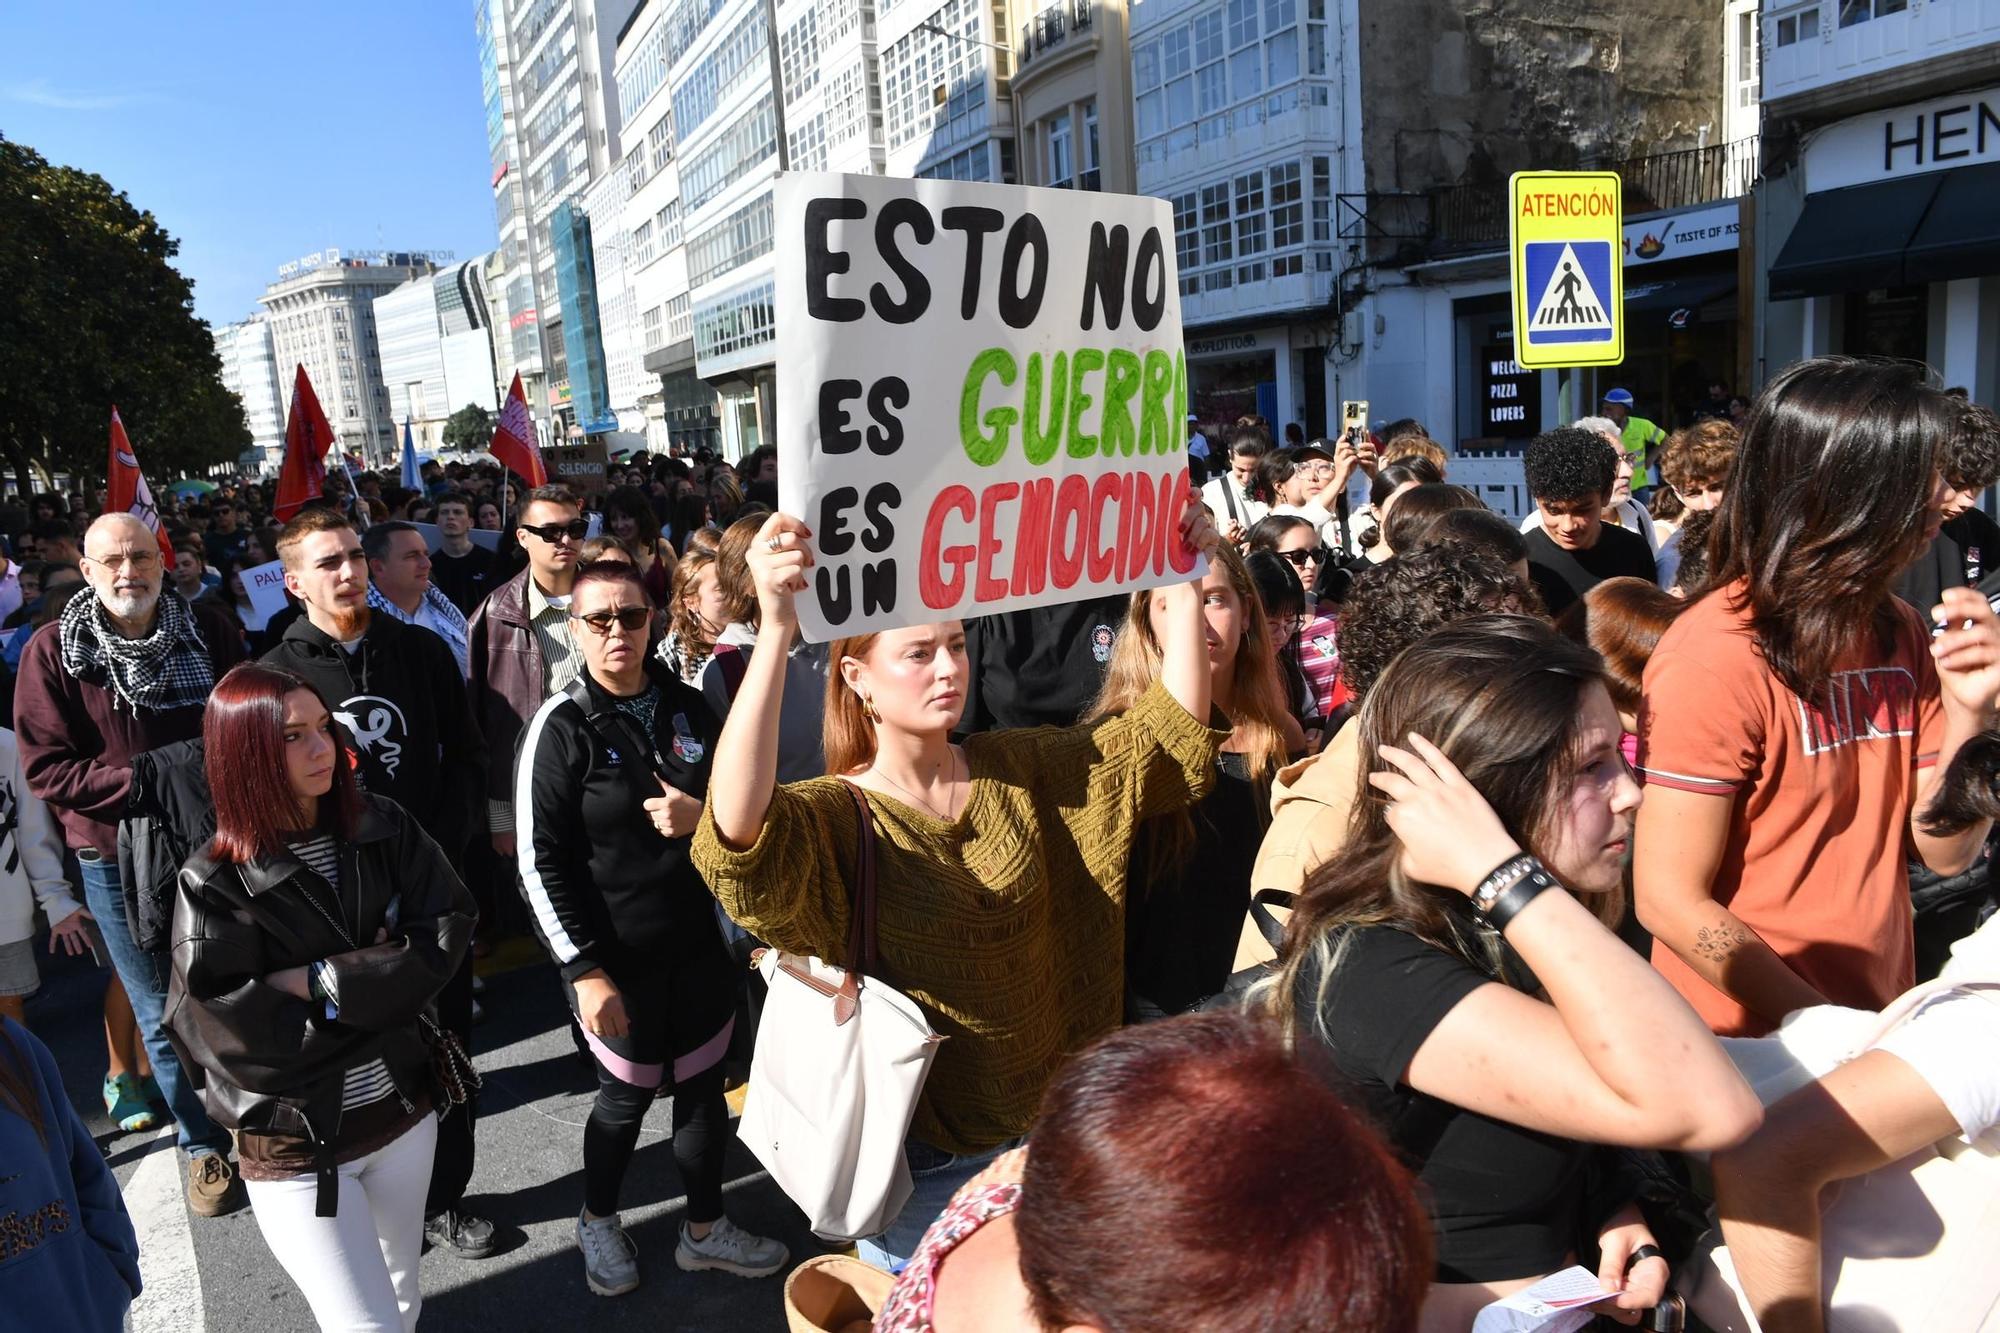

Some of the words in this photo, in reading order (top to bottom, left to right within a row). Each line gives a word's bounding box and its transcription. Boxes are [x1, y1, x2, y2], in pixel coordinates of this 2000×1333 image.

[1522, 186, 1613, 216] ATENCIÓN
[1674, 229, 1705, 244] TASTE
[1708, 226, 1722, 238] OF
[804, 197, 1049, 329] ESTO
[1080, 221, 1165, 332] NO
[818, 376, 910, 456] ES
[959, 347, 1188, 467] GUERRA
[1491, 383, 1517, 398] PIZZA
[1491, 405, 1525, 422] LOVERS
[818, 482, 902, 556] ES
[815, 558, 897, 626] UN
[919, 466, 1197, 610] GENOCIDIO
